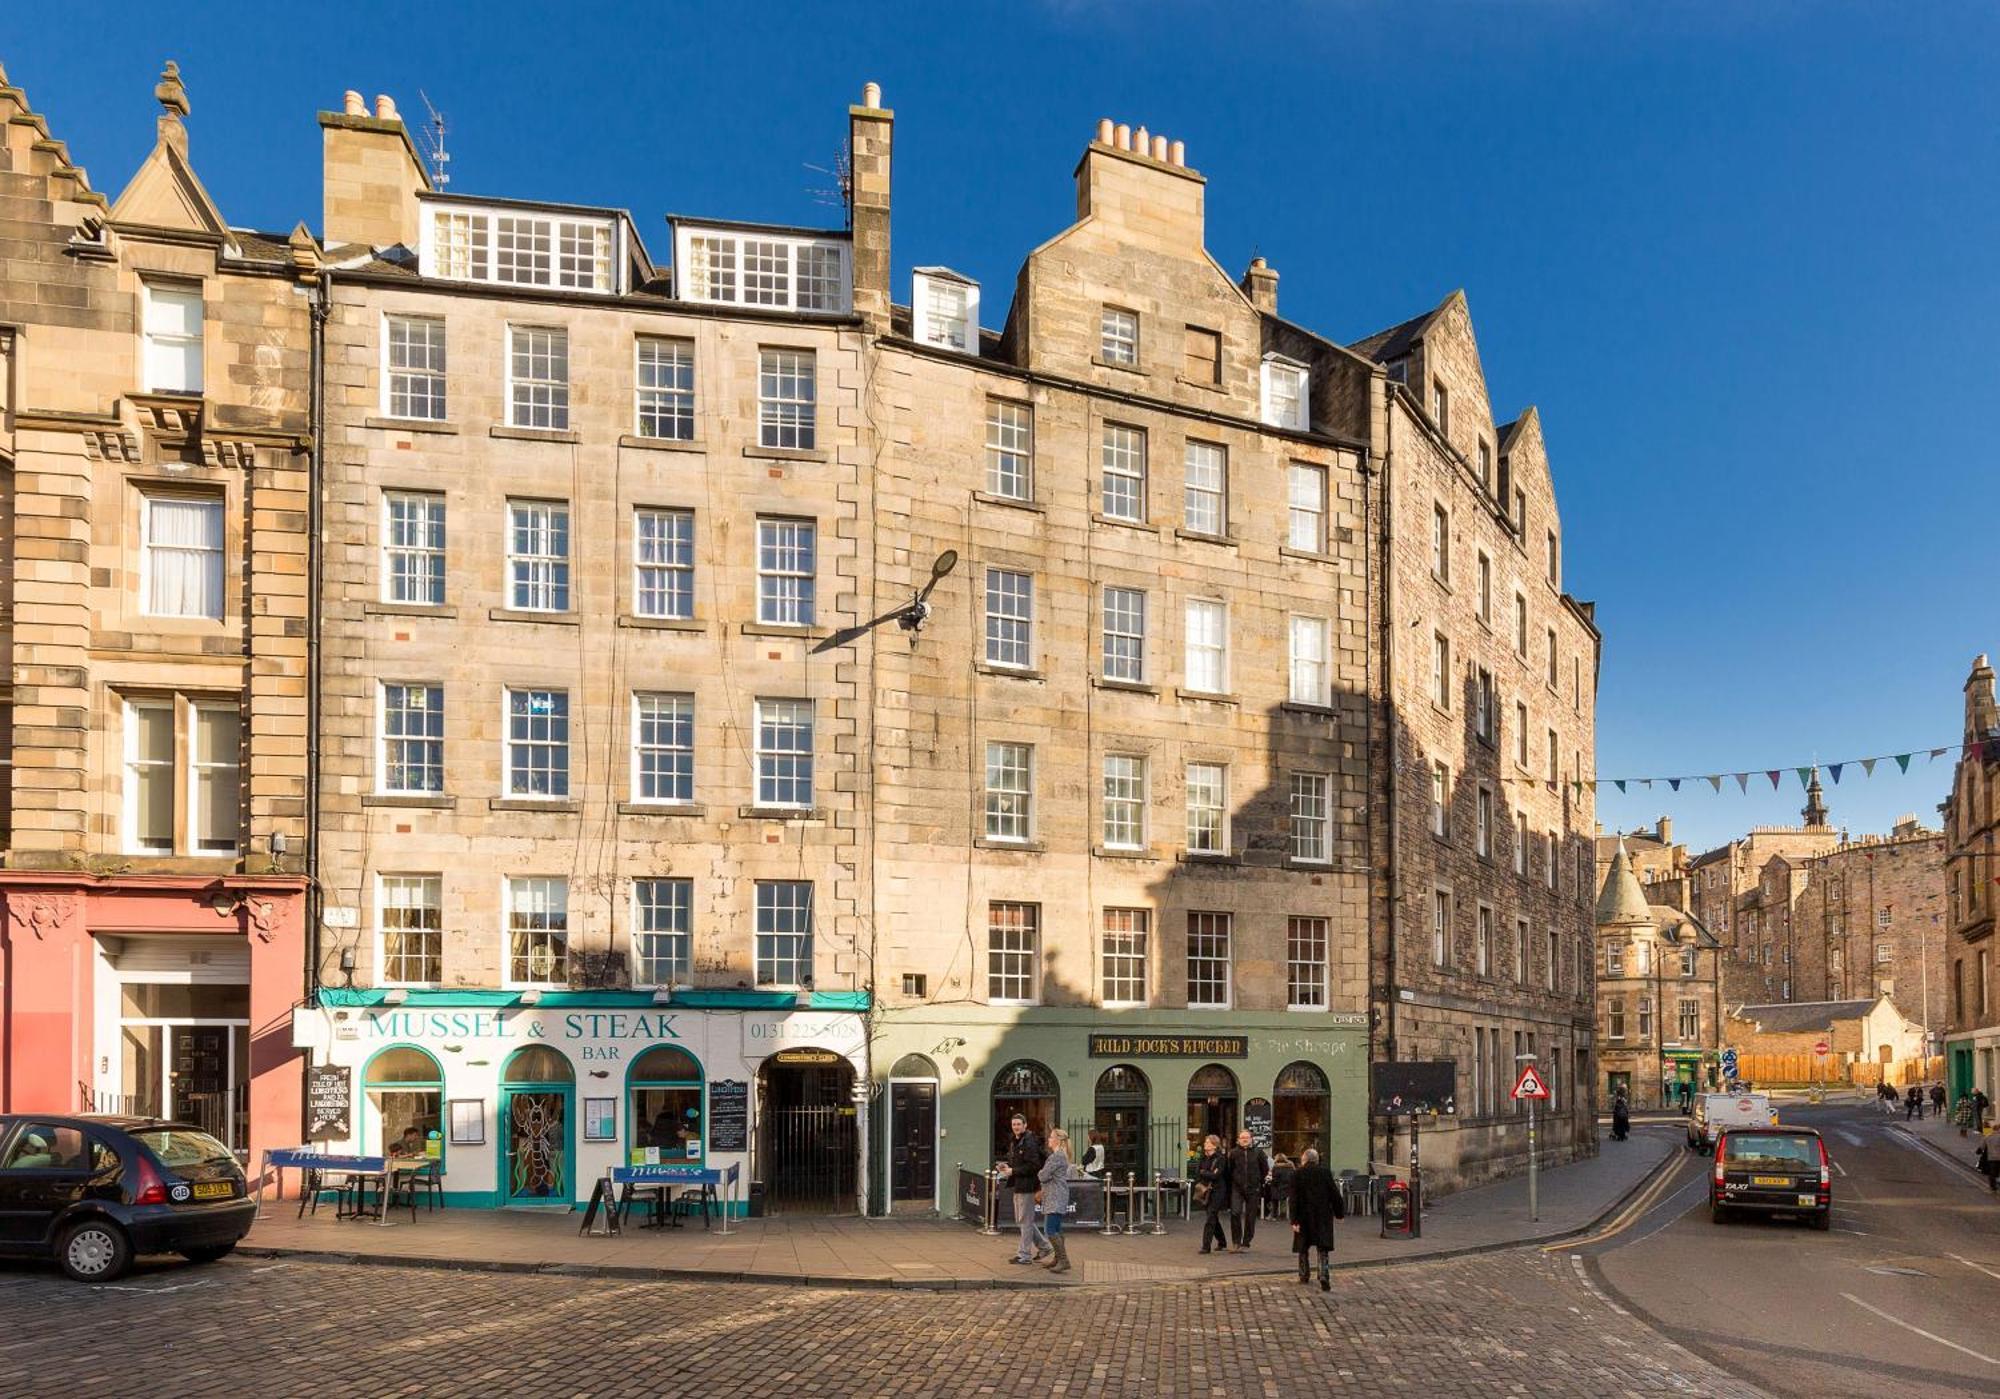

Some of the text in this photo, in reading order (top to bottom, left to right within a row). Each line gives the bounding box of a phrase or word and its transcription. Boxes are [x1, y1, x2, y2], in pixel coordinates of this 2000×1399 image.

[368, 1012, 681, 1039] MUSSEL & STEAK
[751, 1023, 785, 1039] 0131
[582, 1046, 619, 1060] BAR
[1095, 1038, 1131, 1054] AULD
[1135, 1038, 1179, 1054] JOCK'S
[174, 1187, 187, 1198] GB
[1725, 1182, 1748, 1190] TAXI
